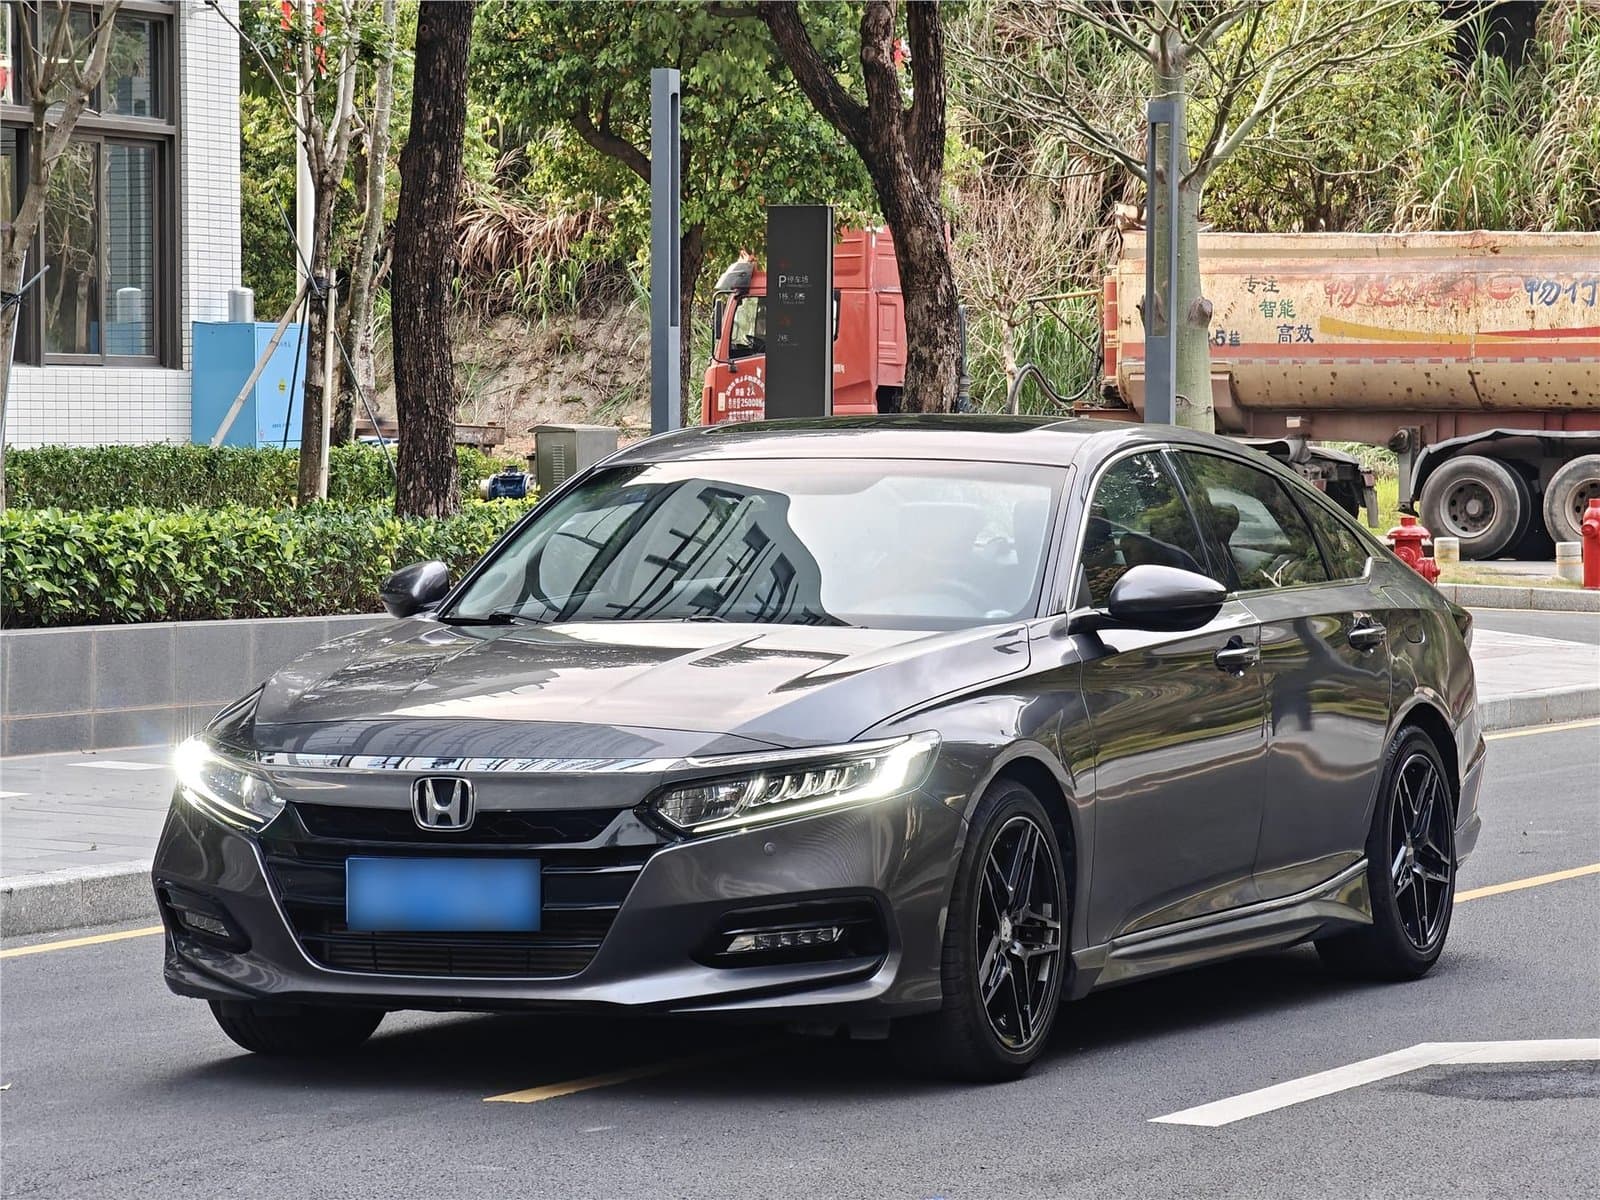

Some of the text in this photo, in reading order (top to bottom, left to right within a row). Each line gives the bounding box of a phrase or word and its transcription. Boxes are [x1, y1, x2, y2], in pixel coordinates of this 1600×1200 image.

[778, 275, 787, 288] P
[1242, 274, 1280, 294] 专注
[1259, 299, 1297, 319] 智能
[1276, 323, 1315, 344] 高效
